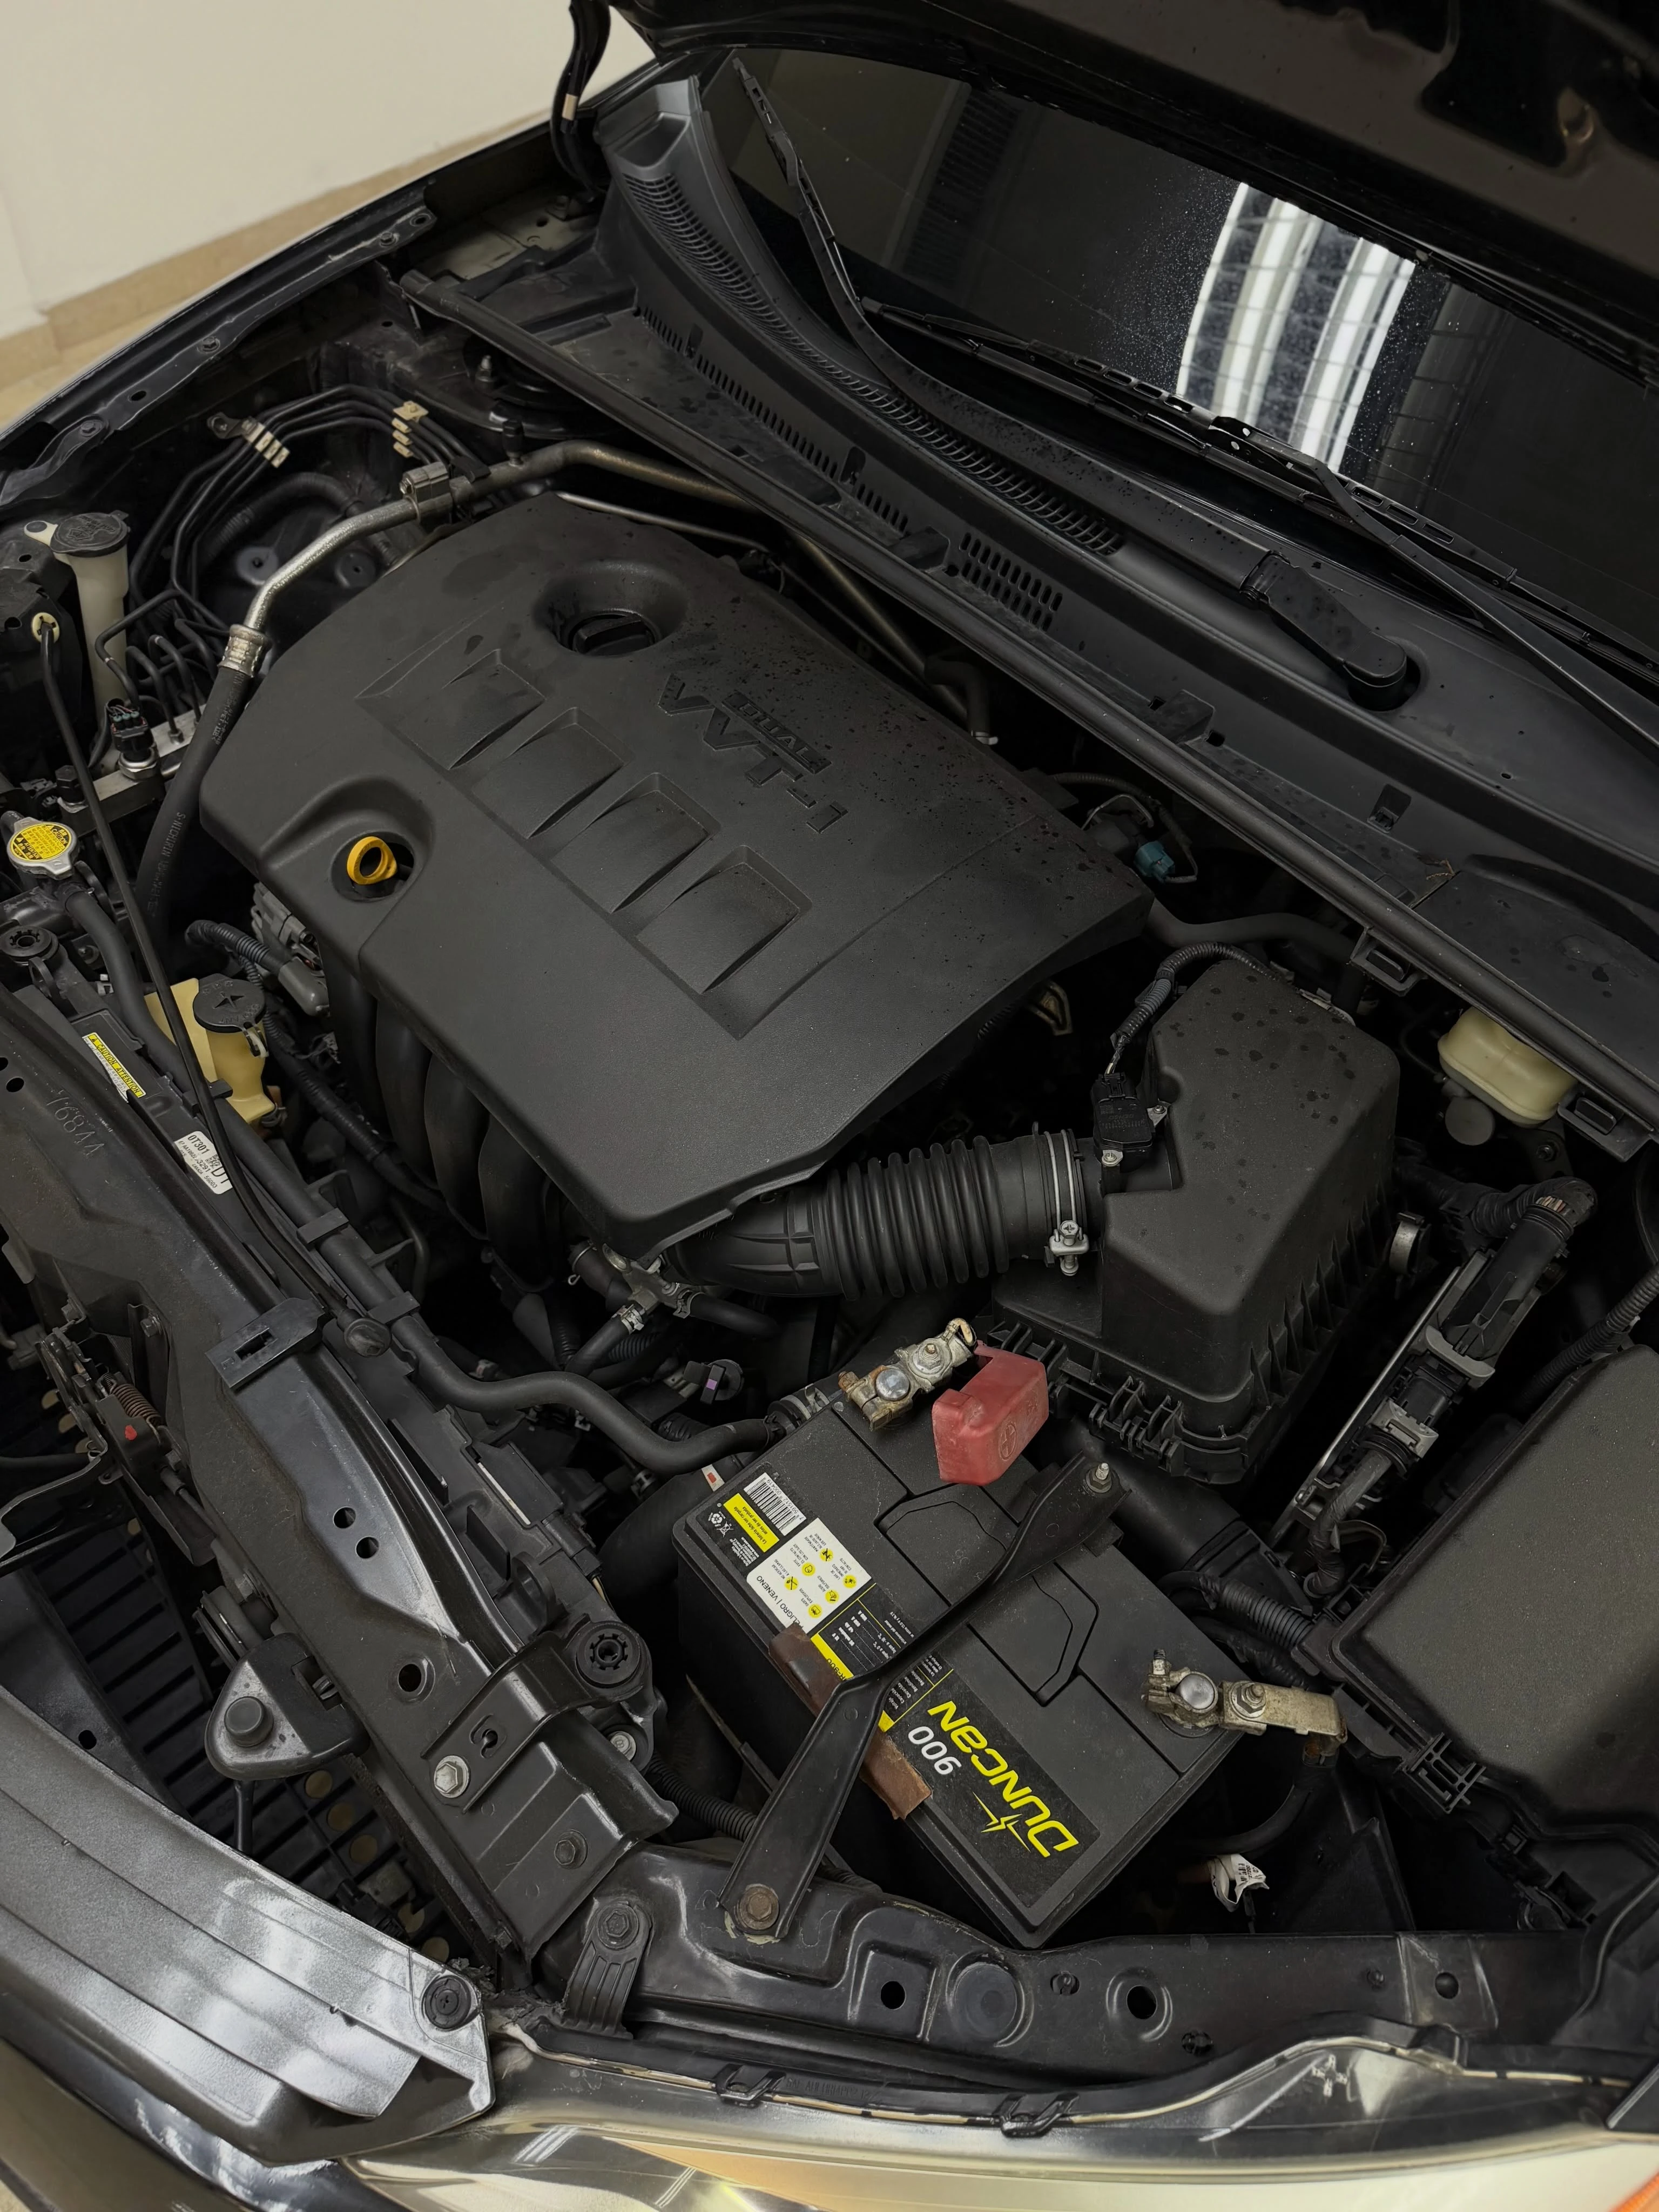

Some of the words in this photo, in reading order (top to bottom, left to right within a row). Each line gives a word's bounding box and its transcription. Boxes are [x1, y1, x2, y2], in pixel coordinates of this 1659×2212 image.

[740, 703, 812, 766] DUAL
[52, 828, 68, 845] CAUTION
[24, 842, 41, 859] ATTENTION
[97, 1044, 117, 1065] CAUTION
[115, 1067, 140, 1094] ATTENTION
[187, 1135, 210, 1154] 0T301
[204, 1175, 218, 1189] 56003
[766, 1478, 782, 1495] 000419
[733, 1505, 745, 1519] cargada
[741, 1505, 754, 1519] probada
[783, 1497, 799, 1514] 591512
[746, 1522, 755, 1530] debe
[752, 1528, 763, 1540] batería
[759, 1526, 767, 1535] antes
[755, 1574, 779, 1601] VENENO
[890, 1687, 906, 1703] Capacida
[896, 1681, 912, 1698] Capacida
[887, 1696, 900, 1709] Voltaje
[908, 1726, 962, 1775] 900
[927, 1701, 1079, 1858] DUNCAN
